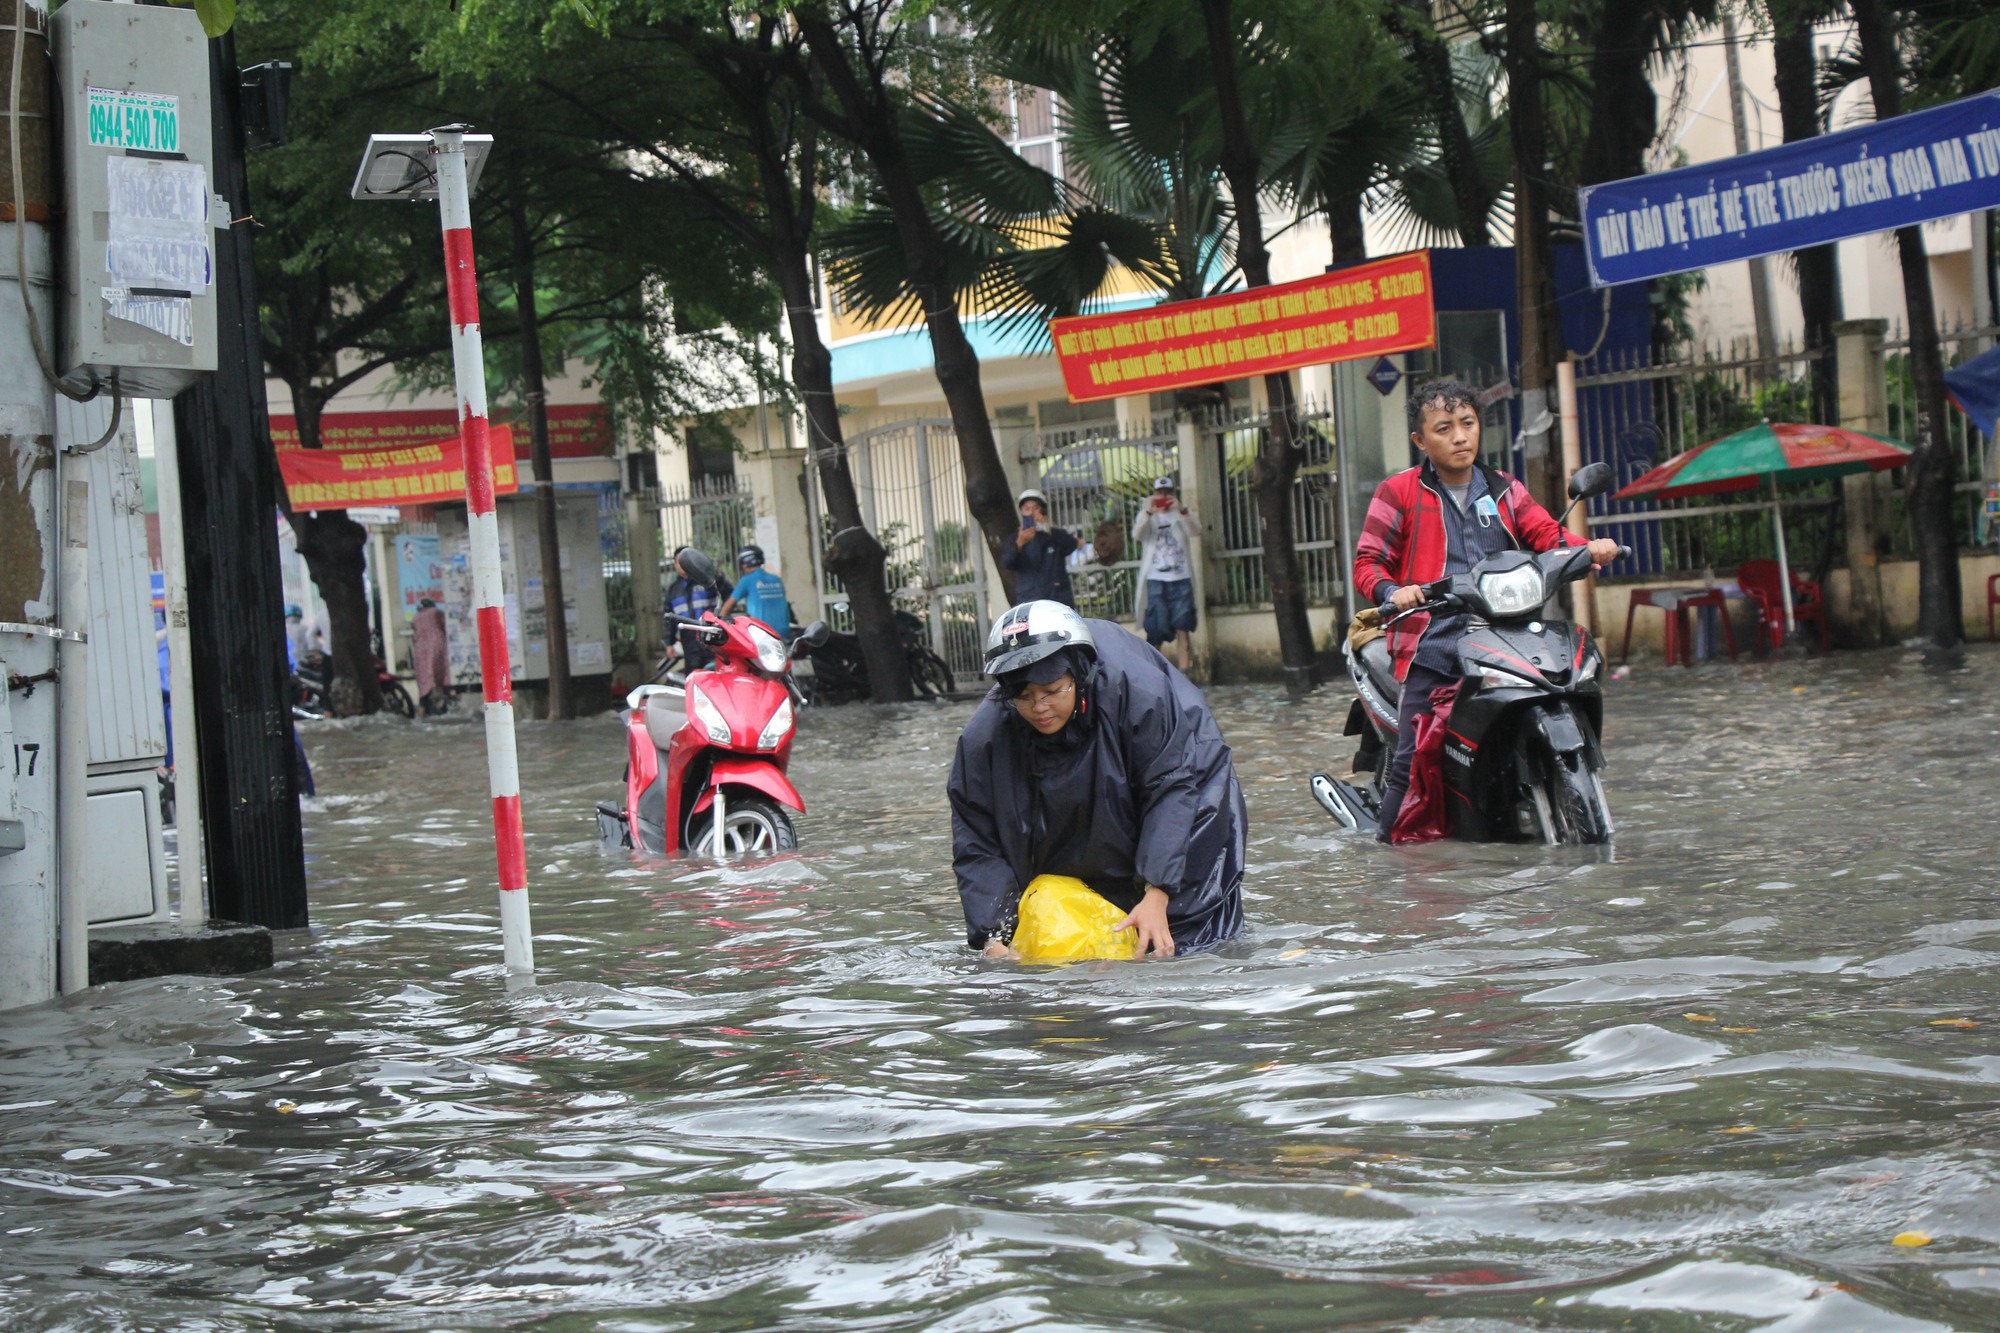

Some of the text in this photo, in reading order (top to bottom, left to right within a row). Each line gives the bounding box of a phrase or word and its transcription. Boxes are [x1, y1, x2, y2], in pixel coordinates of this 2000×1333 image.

[90, 103, 176, 151] 0944.500.700
[1629, 197, 1665, 252] BẢO
[1664, 192, 1689, 250] VỆ
[1720, 180, 1747, 239] HỆ
[1743, 169, 1781, 228] TRẺ
[1778, 162, 1840, 221] TRƯỚC
[1839, 143, 1893, 208] HIỂM
[1890, 146, 1937, 201] HỌA
[1932, 137, 1972, 187] MA
[14, 743, 40, 776] 17
[1445, 743, 1471, 768] YAMAHA
